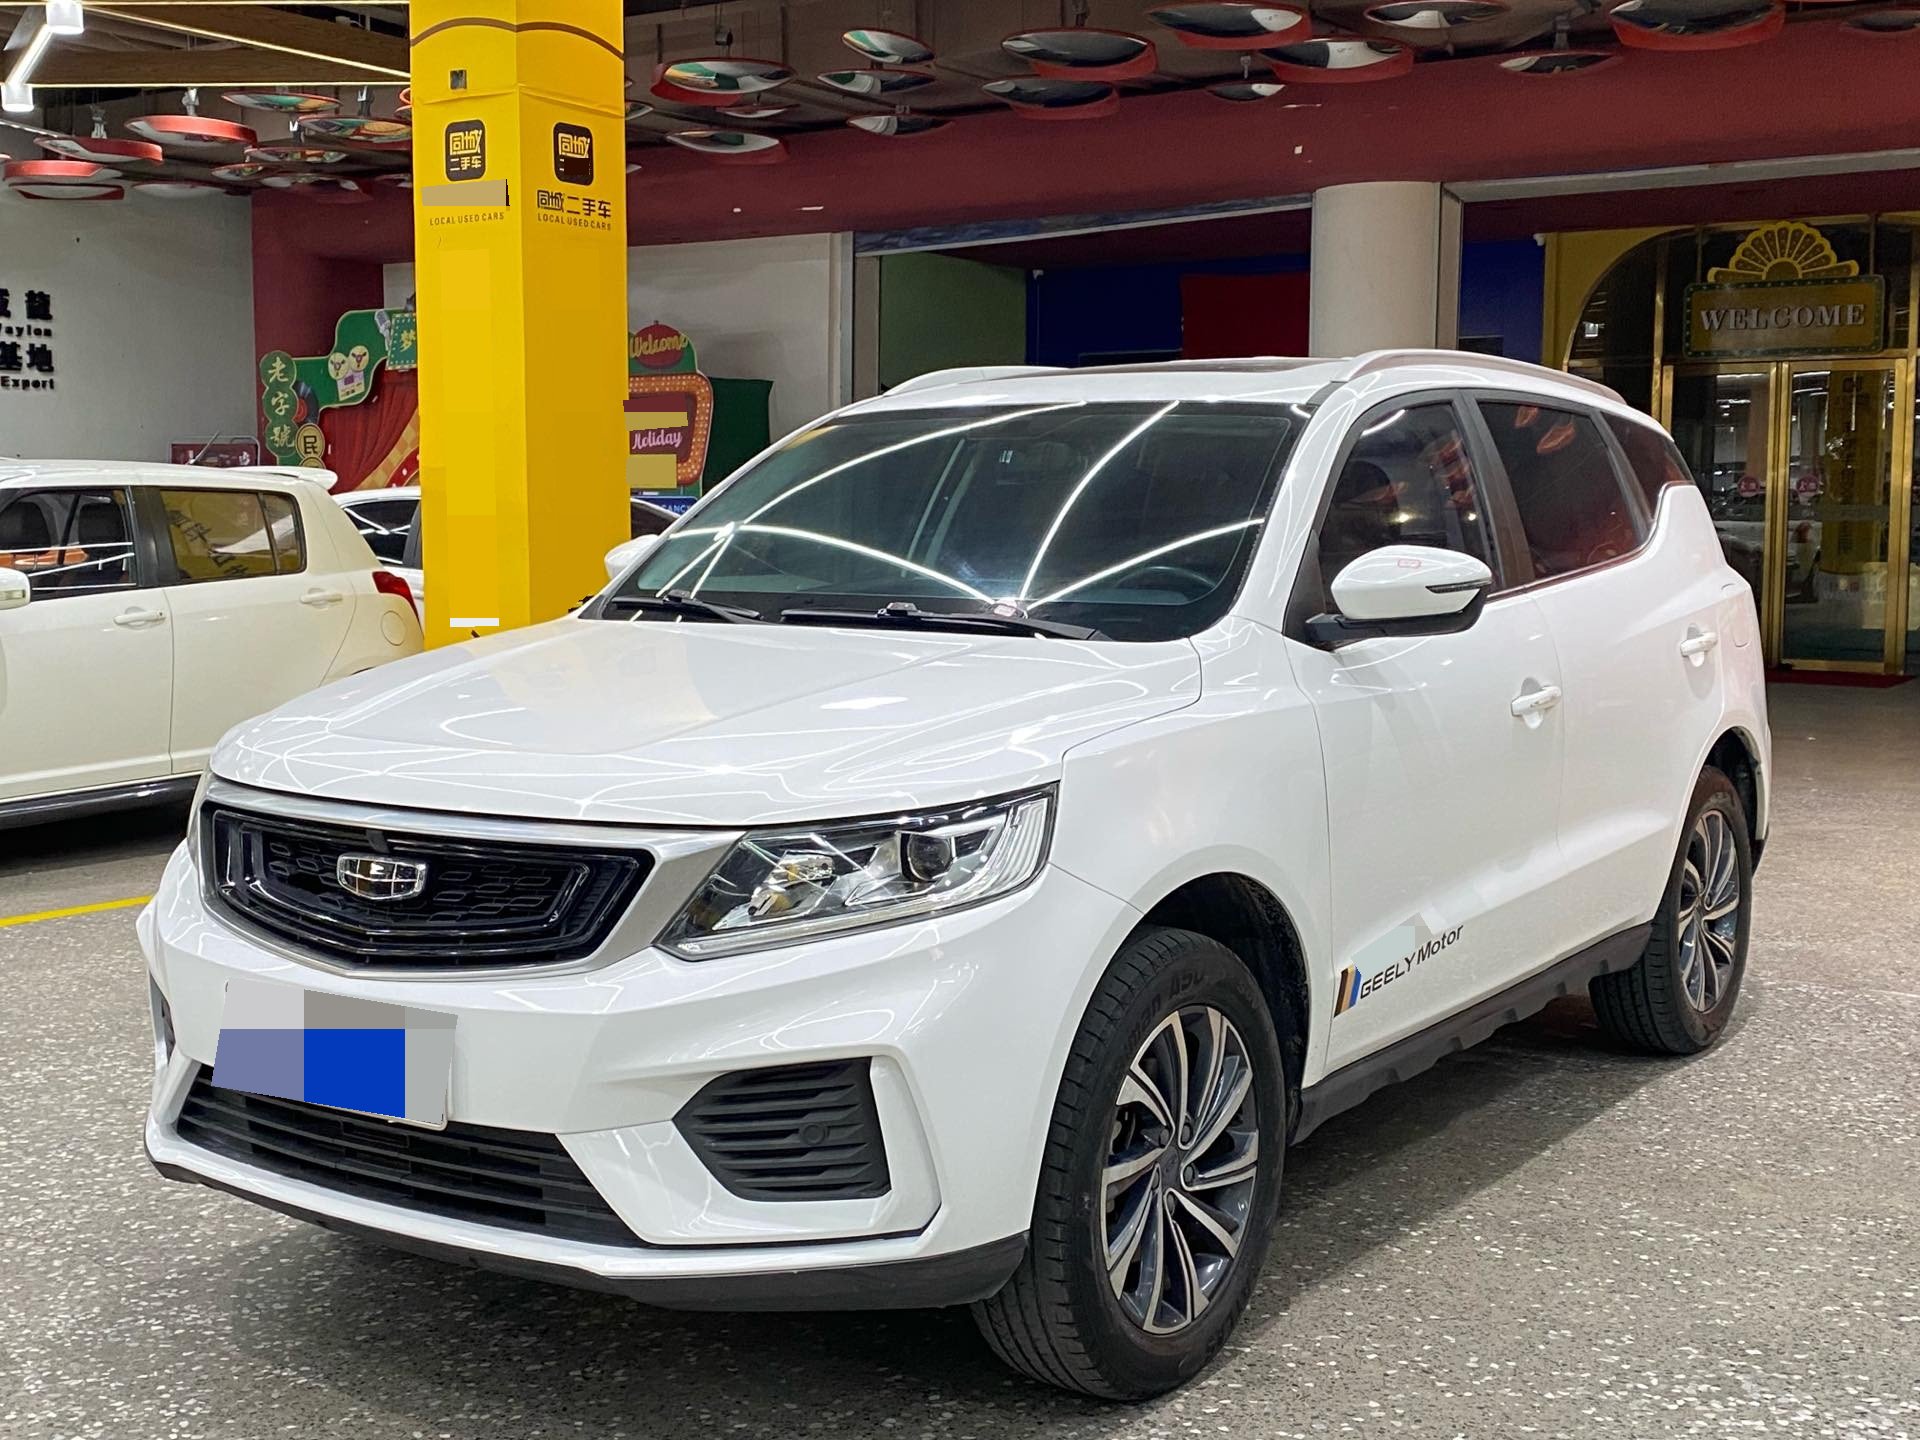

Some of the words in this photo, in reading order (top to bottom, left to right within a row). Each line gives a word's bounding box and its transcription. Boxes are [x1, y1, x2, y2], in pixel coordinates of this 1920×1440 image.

[450, 156, 482, 171] 二手车
[537, 189, 611, 219] 同城二手车
[430, 215, 455, 226] LOCAL
[458, 214, 480, 224] USED
[482, 212, 504, 222] CARS
[538, 213, 565, 225] LOCAL
[567, 217, 589, 228] USED
[590, 219, 611, 231] CARS
[1701, 303, 1865, 331] WELCOME
[0, 323, 52, 337] aylon
[629, 334, 688, 358] Welcome
[268, 356, 296, 448] 老字號
[632, 429, 683, 450] Holiday
[1360, 951, 1416, 1000] GEELY
[1417, 924, 1464, 965] Motor
